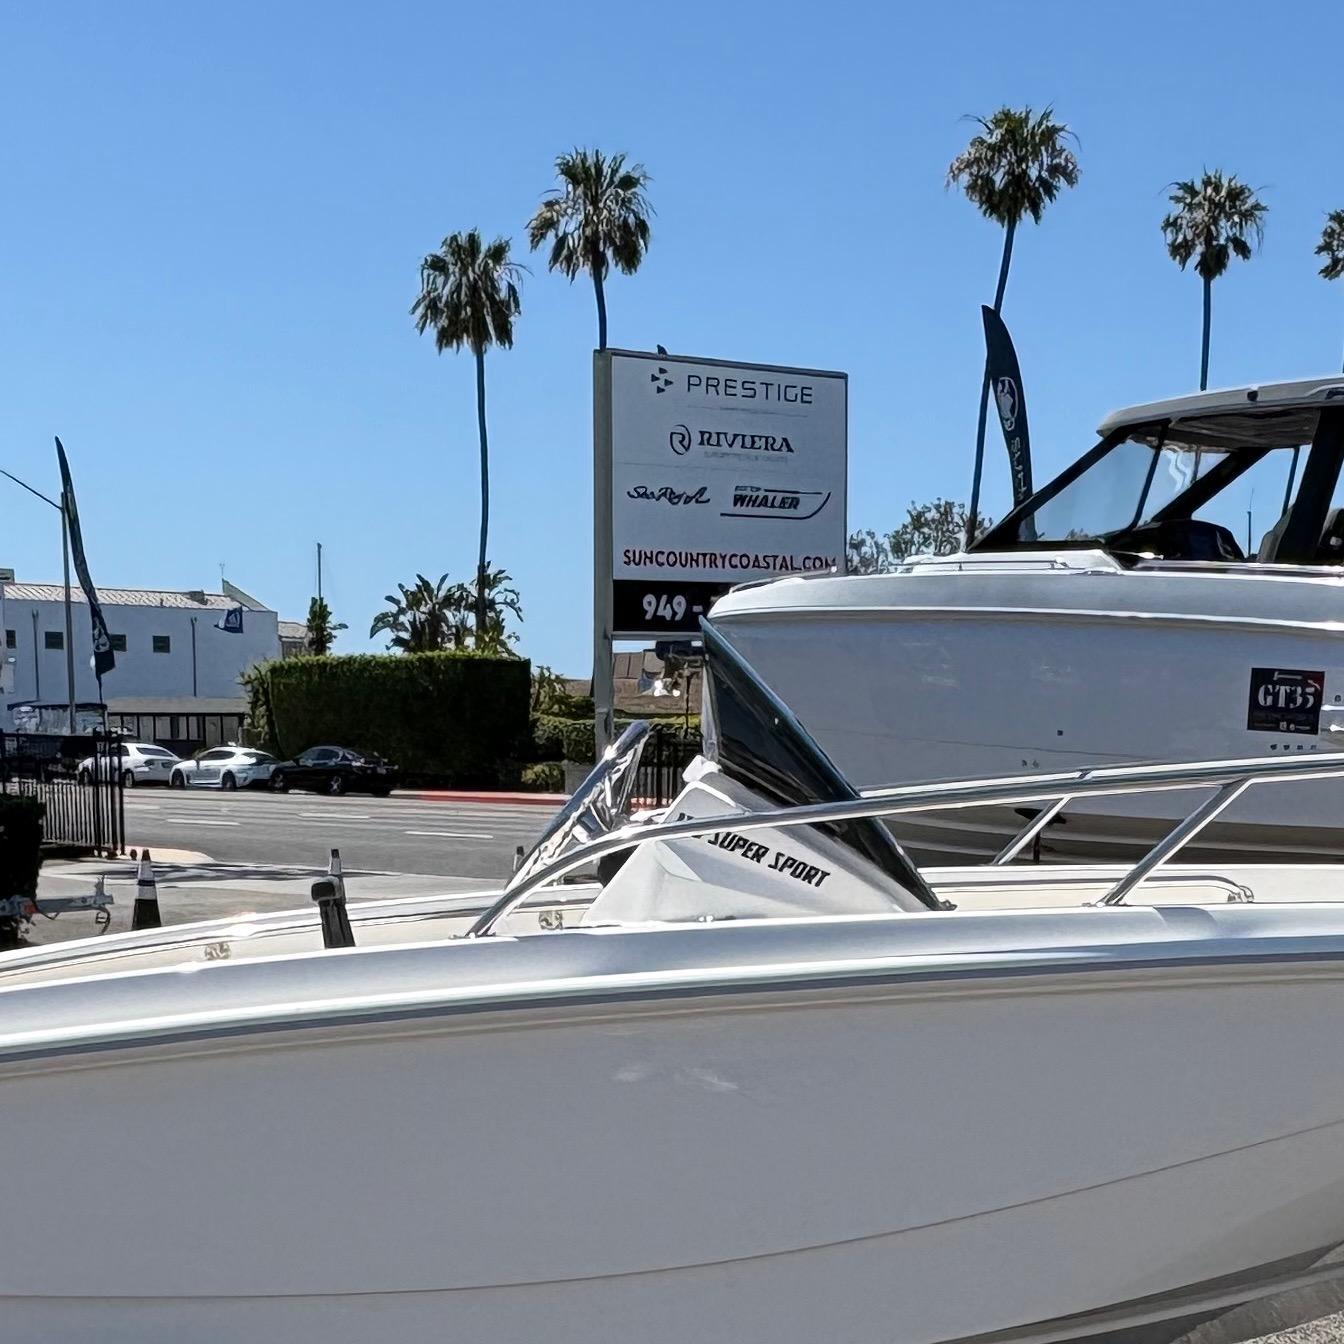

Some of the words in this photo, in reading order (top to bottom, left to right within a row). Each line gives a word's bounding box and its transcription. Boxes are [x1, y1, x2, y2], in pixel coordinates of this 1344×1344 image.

[687, 374, 813, 404] PRESTIGE
[698, 430, 794, 453] RIVIERA
[732, 494, 801, 510] WHALER
[1257, 684, 1315, 709] GT35
[707, 830, 770, 863] SUPER
[768, 850, 831, 888] SPORT
